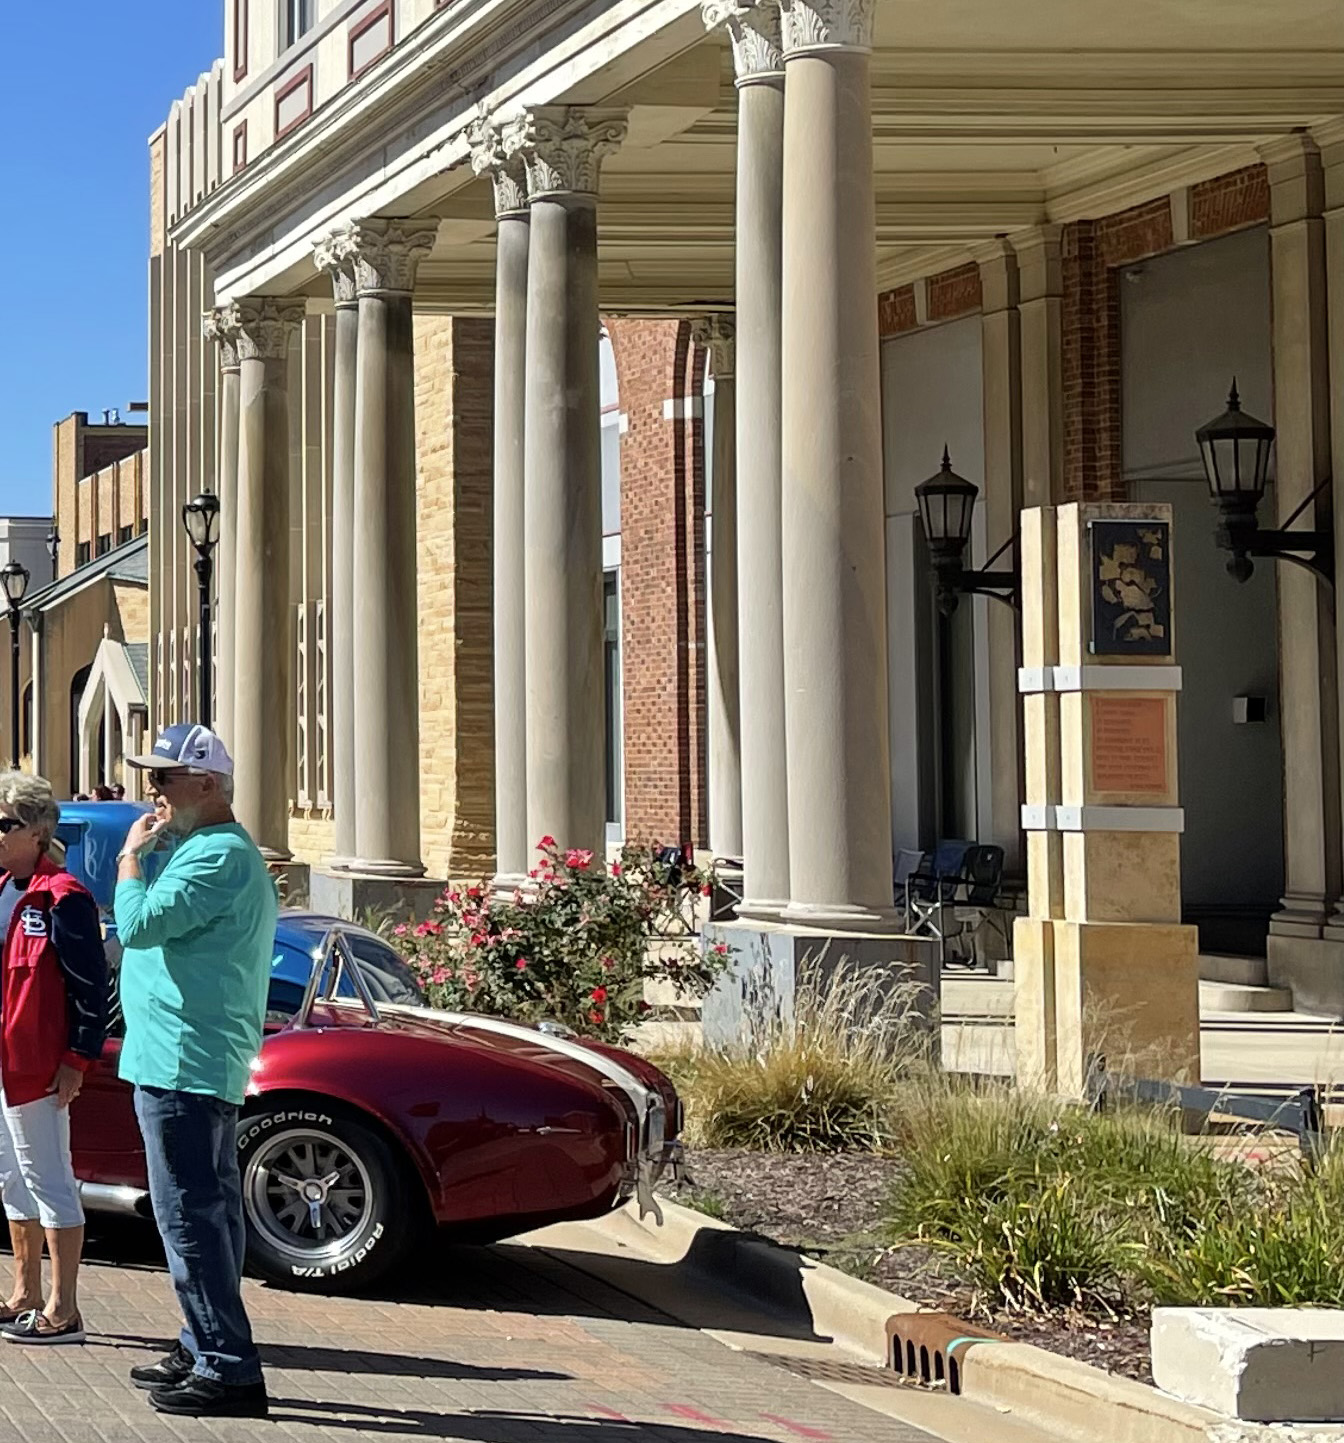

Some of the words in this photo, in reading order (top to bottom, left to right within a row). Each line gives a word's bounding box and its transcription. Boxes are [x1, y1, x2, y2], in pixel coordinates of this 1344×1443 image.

[238, 1110, 333, 1150] Goodrich
[330, 1222, 384, 1275] Radial
[291, 1265, 324, 1278] T/A
